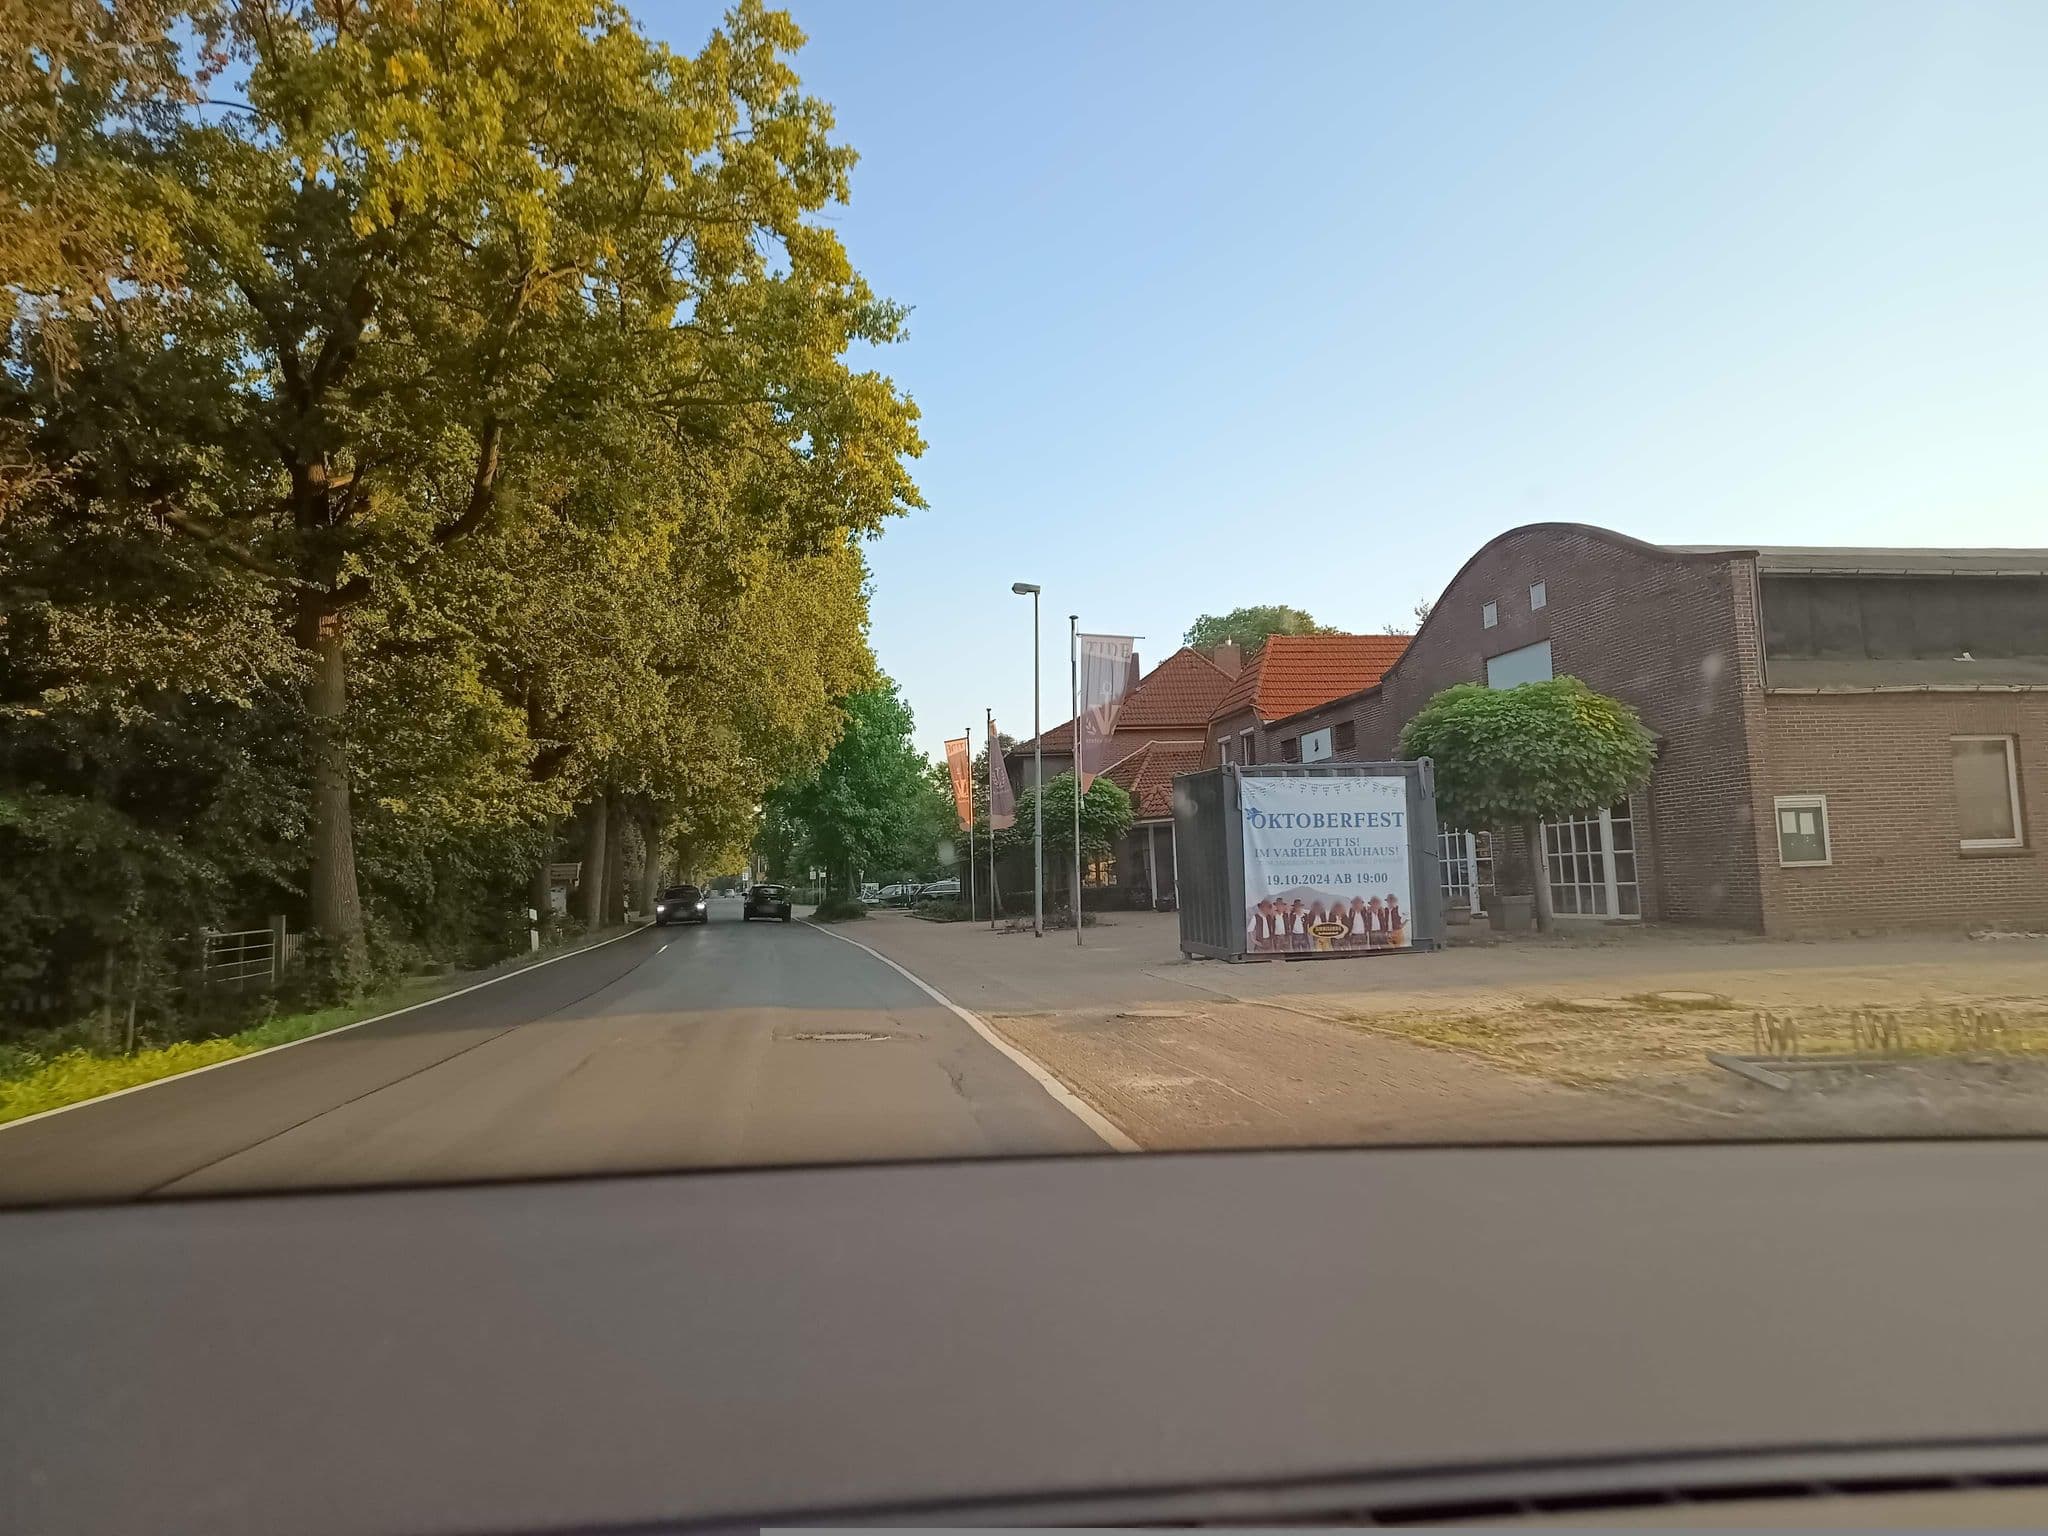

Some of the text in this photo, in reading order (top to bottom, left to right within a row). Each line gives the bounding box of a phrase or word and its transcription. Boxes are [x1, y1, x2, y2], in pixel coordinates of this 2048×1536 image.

[1251, 811, 1405, 829] OKTOBERFEST
[1293, 837, 1360, 848] O'ZAPFT IS!
[1255, 846, 1399, 858] IM VARELER BRAUHAUS!
[1267, 873, 1388, 885] 19.10.2024 AB 19:00
